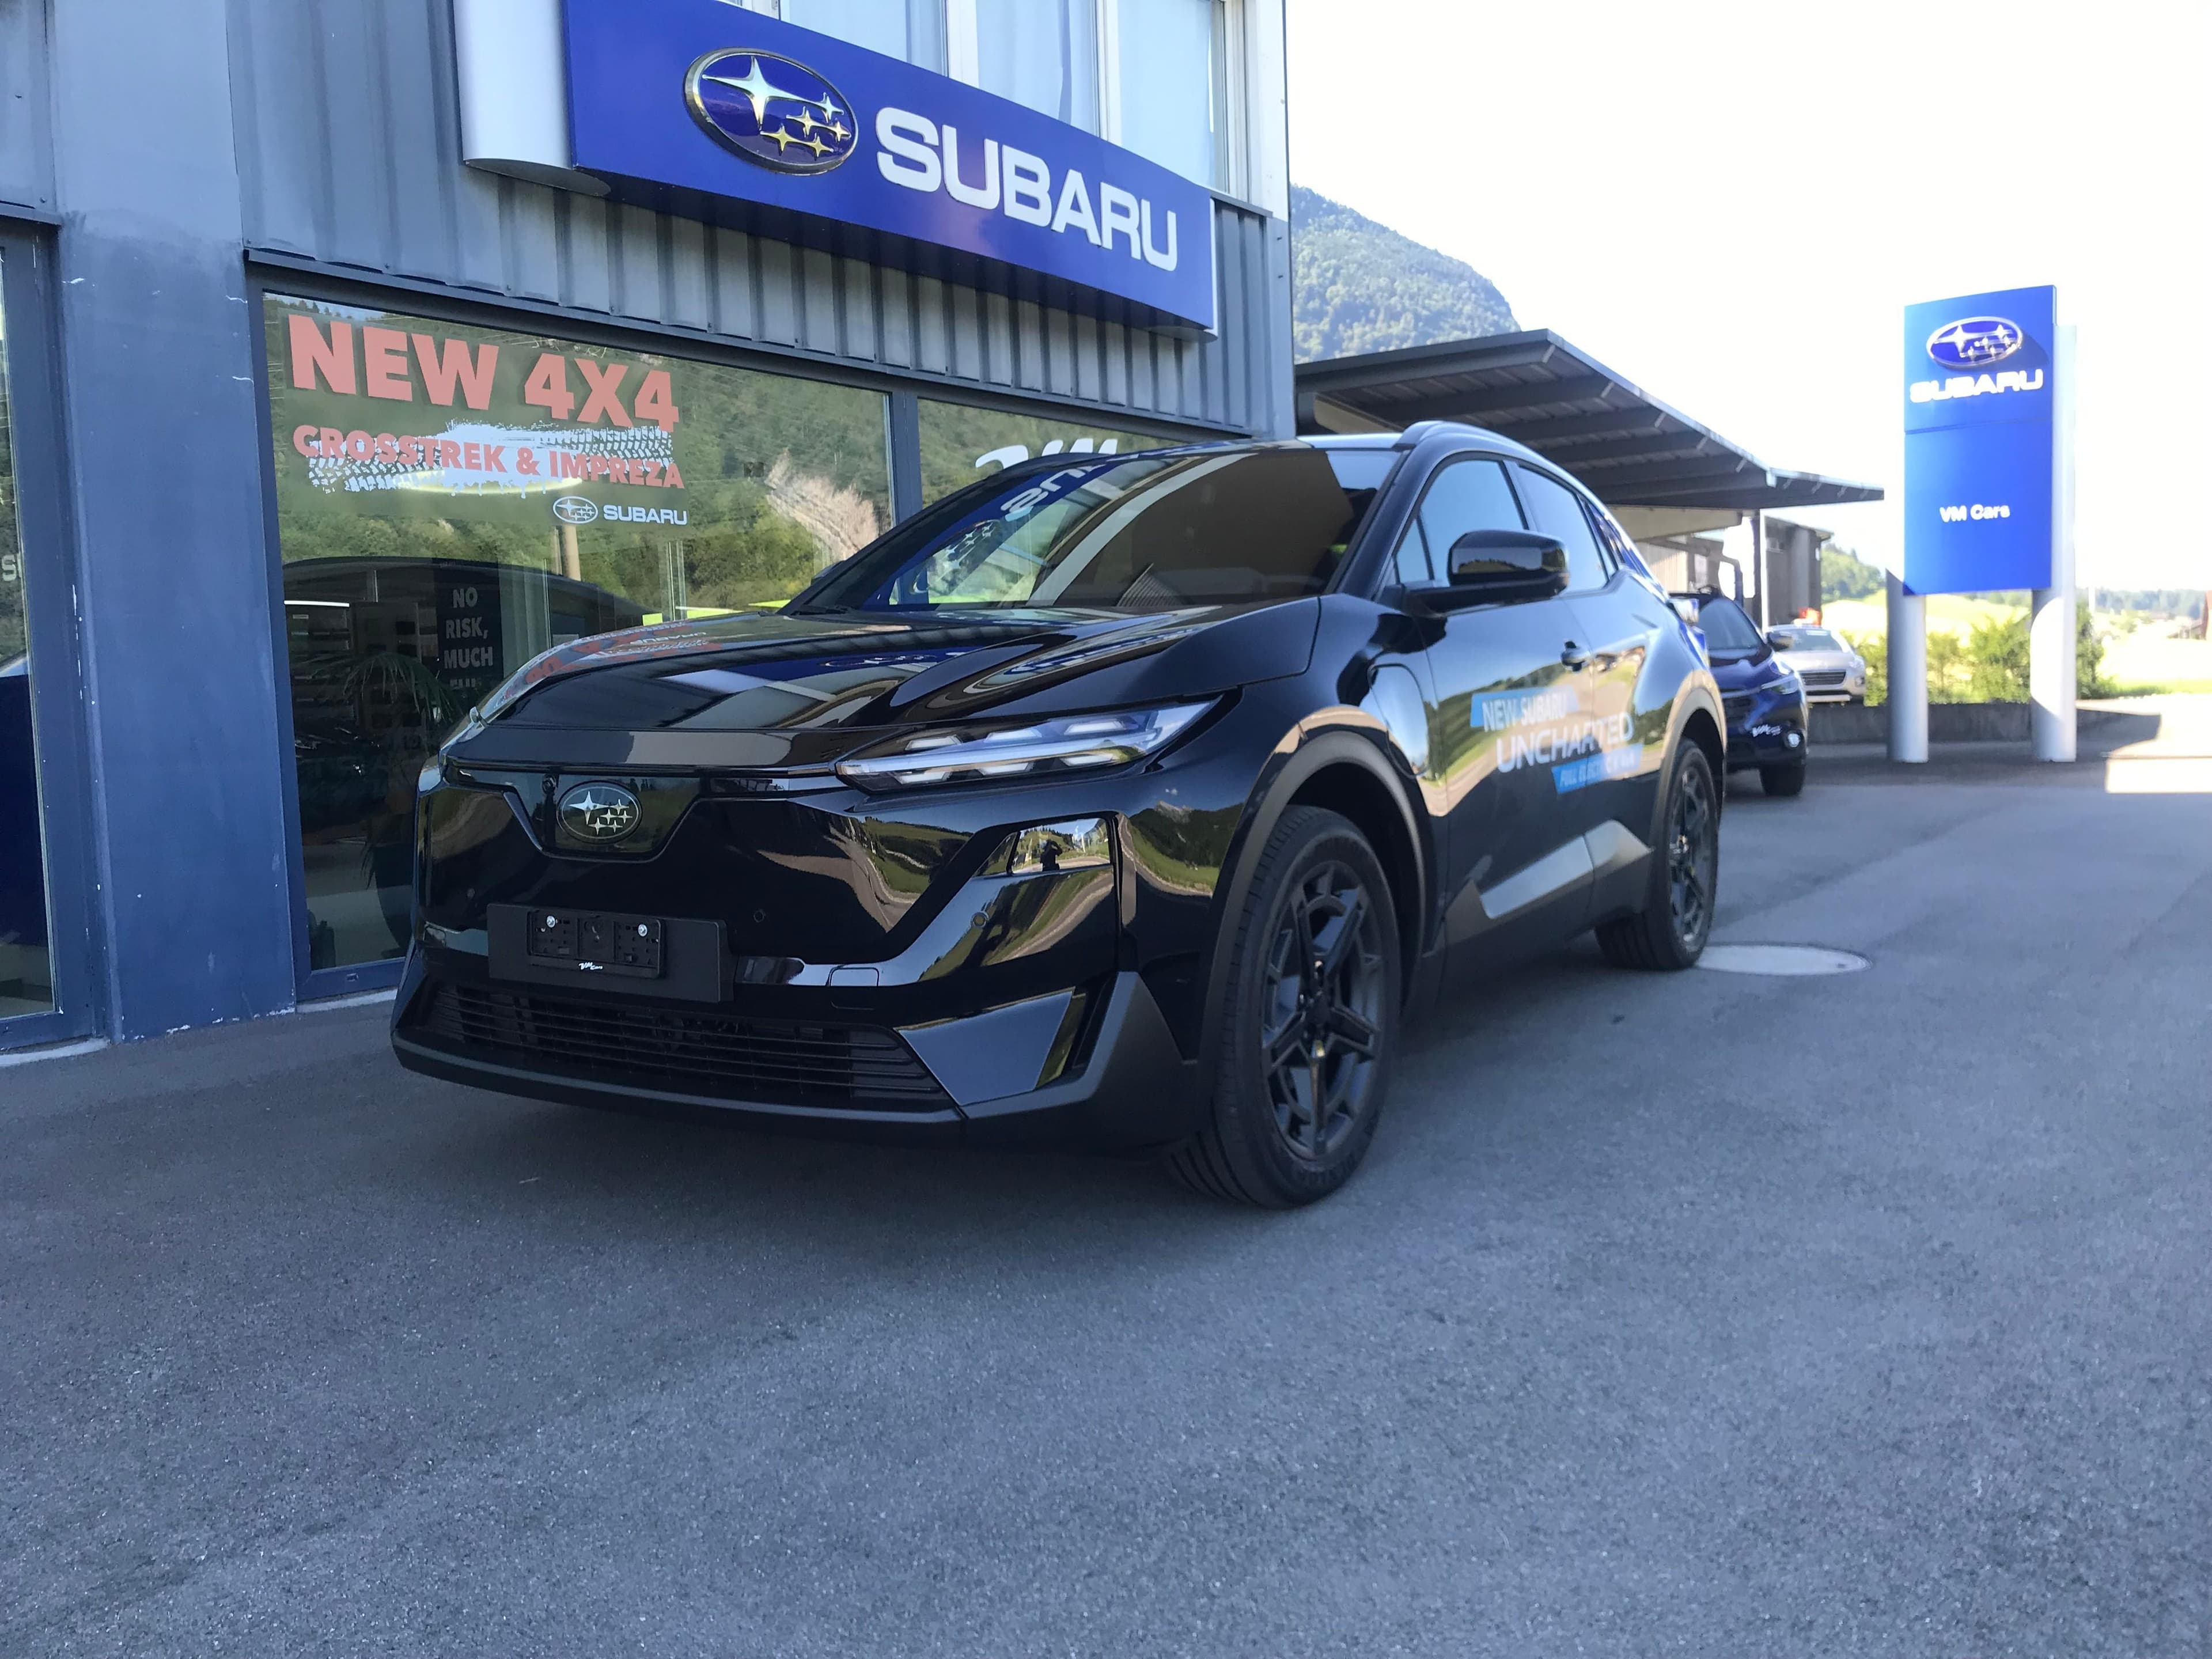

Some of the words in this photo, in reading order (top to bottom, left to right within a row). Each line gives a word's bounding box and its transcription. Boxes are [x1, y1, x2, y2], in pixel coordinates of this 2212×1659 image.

[875, 106, 1178, 272] SUBARU
[288, 313, 499, 411] NEW
[524, 353, 679, 433] 4X4
[1909, 369, 2044, 403] SUBARU
[292, 424, 507, 474] CROSSTREK
[516, 447, 540, 477] &
[550, 450, 685, 489] IMPREZA
[603, 503, 687, 525] SUBARU
[1939, 505, 1967, 522] VM
[1970, 503, 2011, 521] Cars
[452, 586, 478, 608] NO
[445, 616, 488, 639] RISK,
[443, 646, 494, 669] MUCH
[1482, 698, 1517, 733] NEW
[1497, 711, 1635, 774] UNCHARTED
